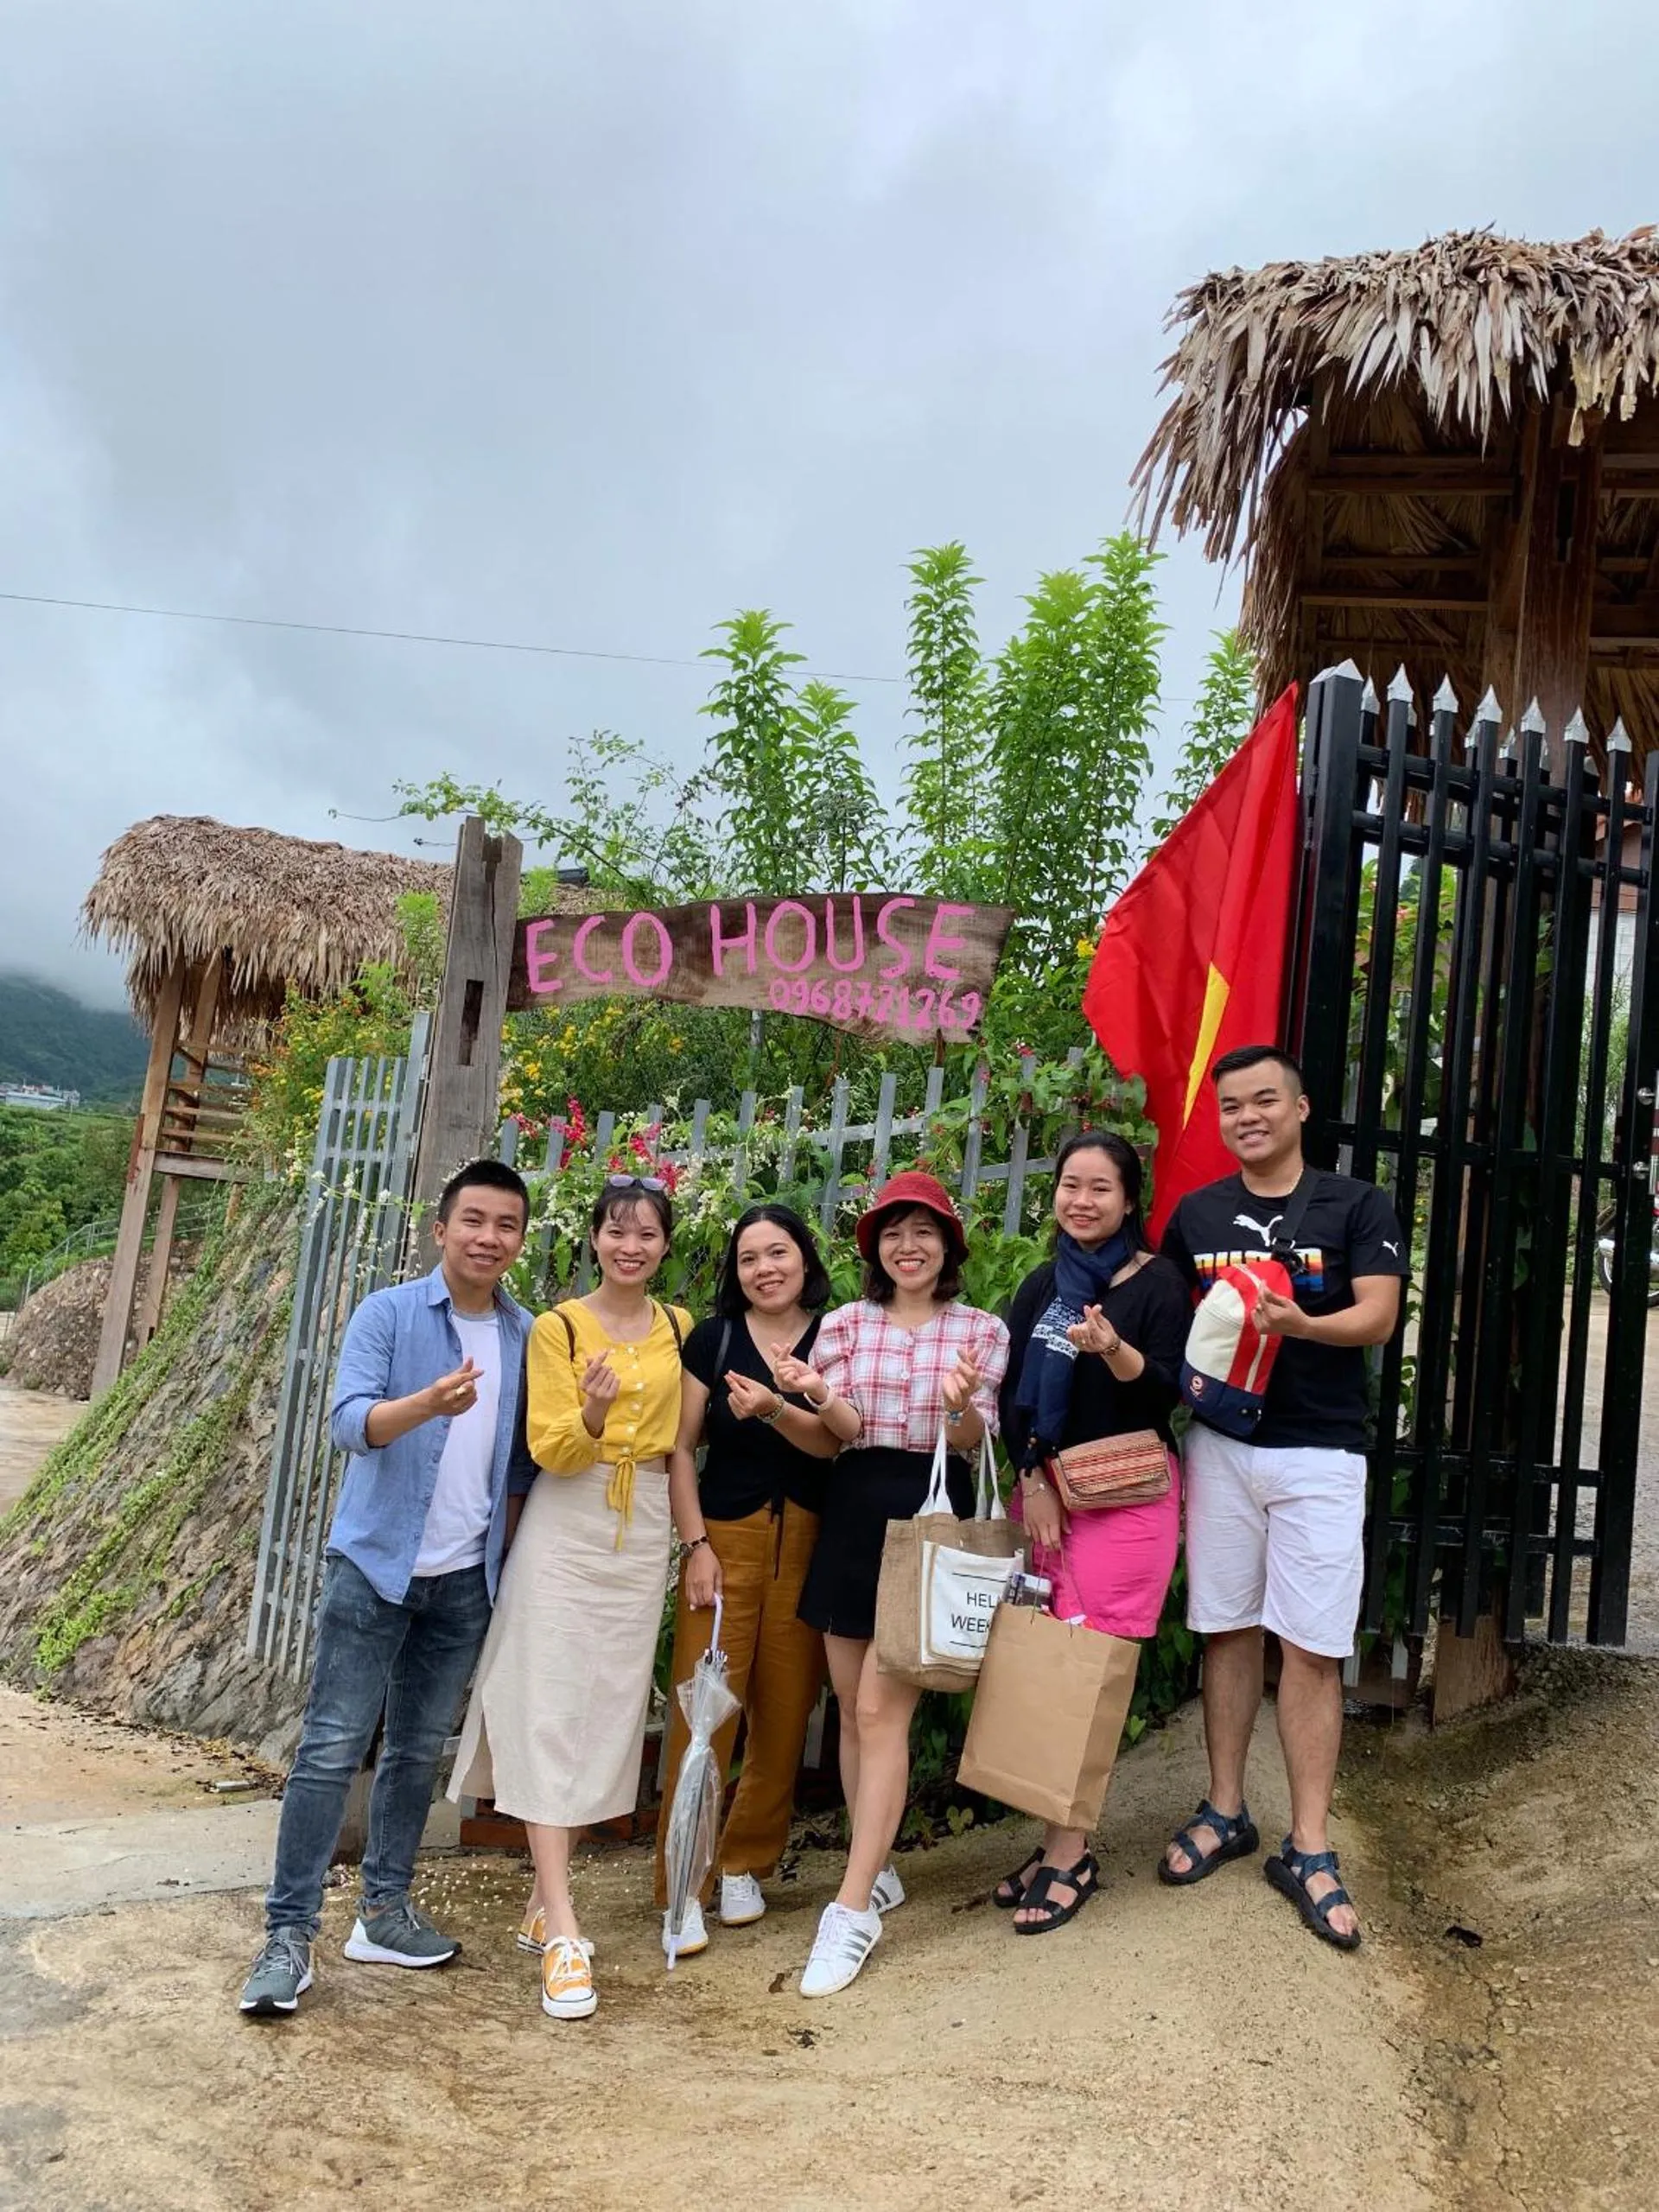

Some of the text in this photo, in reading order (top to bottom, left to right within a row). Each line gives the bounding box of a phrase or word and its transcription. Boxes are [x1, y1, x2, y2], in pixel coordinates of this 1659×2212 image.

[525, 895, 976, 994] ECO HOUSE
[966, 1591, 1000, 1608] HEL
